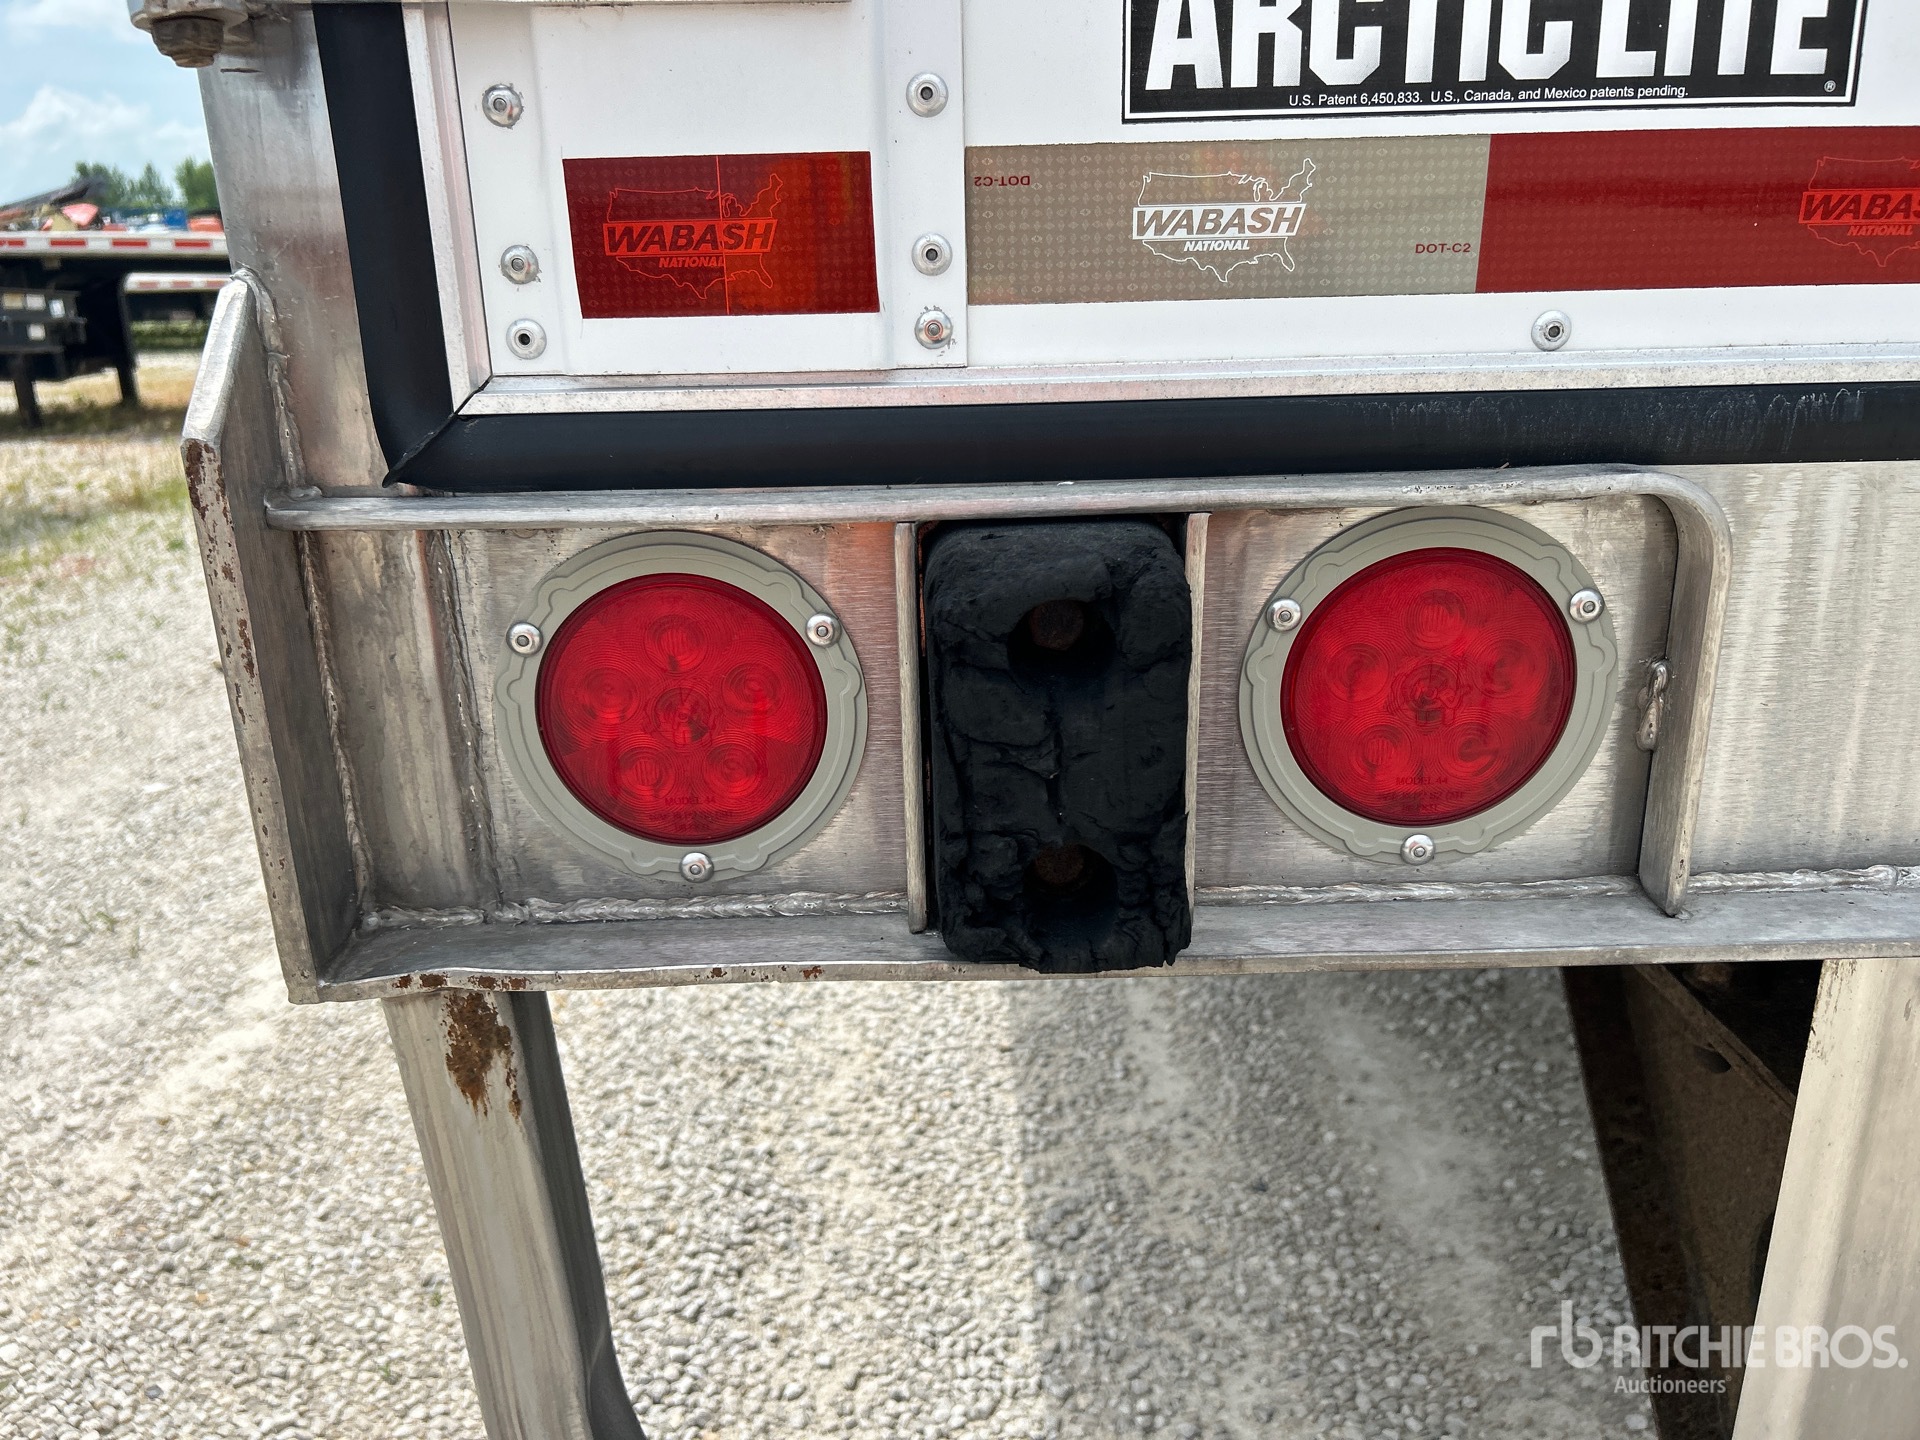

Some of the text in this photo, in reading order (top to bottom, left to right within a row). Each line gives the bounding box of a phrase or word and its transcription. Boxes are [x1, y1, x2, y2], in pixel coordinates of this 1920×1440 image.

[1288, 84, 1689, 106] U.S. Patent 6,450,833. U.S., Canada, and Mexico patents pending.
[1137, 206, 1302, 238] WABASH
[1847, 224, 1914, 236] NATIONAL
[606, 221, 773, 253] WABASH
[1183, 239, 1250, 252] NATIONAL
[1415, 242, 1472, 254] DOT-C2
[658, 256, 725, 269] NATIONAL
